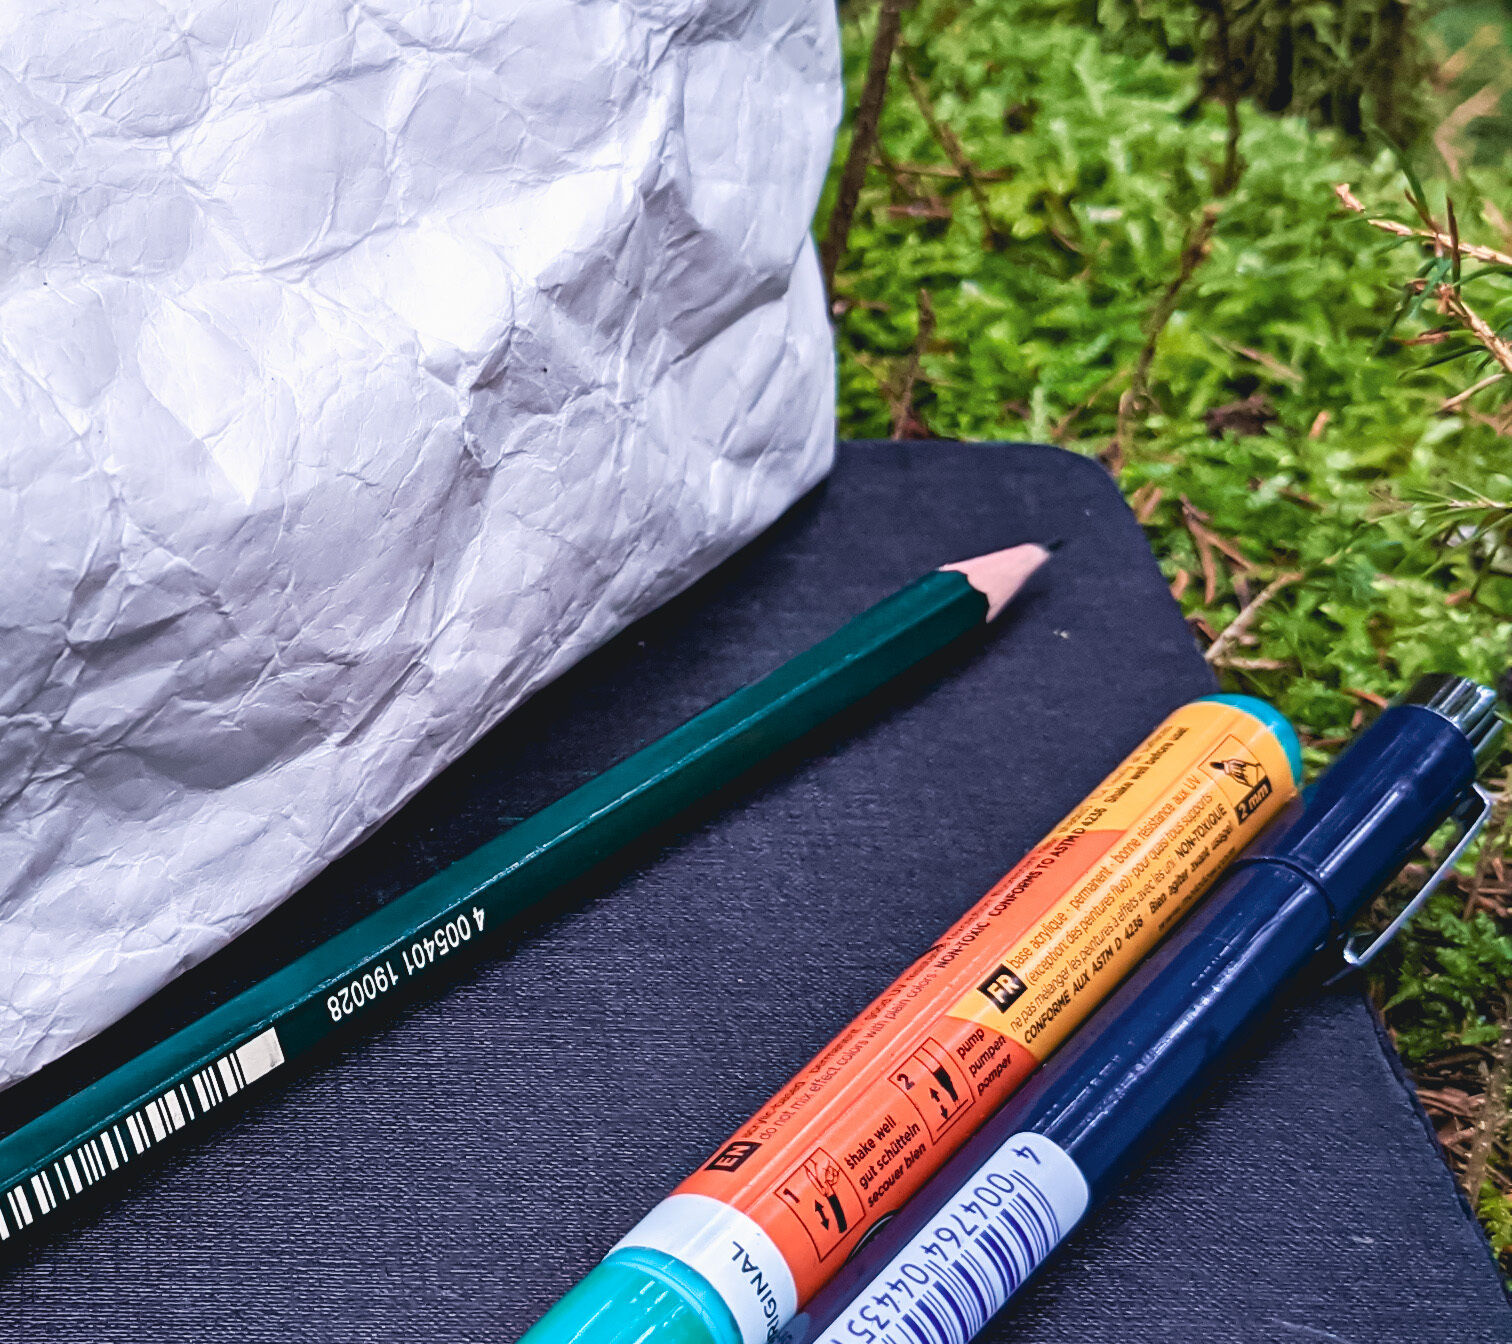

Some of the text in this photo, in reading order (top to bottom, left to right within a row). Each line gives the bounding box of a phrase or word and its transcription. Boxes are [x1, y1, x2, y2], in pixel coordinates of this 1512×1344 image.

[1239, 784, 1269, 821] 2 mm
[1006, 775, 1201, 969] base acrylique permanent bonne résistance aux UV
[1066, 925, 1083, 945] des
[1079, 893, 1116, 934] peintures
[1132, 855, 1151, 879] pour
[1148, 838, 1169, 861] quasi
[1166, 821, 1185, 842] tous
[1181, 793, 1213, 827] supports
[1010, 1016, 1023, 1032] ne
[1020, 1005, 1037, 1025] pas
[1066, 955, 1082, 972] les
[1079, 922, 1115, 964] peintures
[1117, 896, 1139, 923] effets
[1136, 879, 1156, 902] avec
[1151, 869, 1165, 885] les
[1174, 803, 1227, 860] NON-TOXIQUE
[327, 906, 486, 1023] 4 005401 190028
[759, 1127, 777, 1140] do
[774, 1110, 795, 1127] not
[791, 1093, 811, 1110] mix
[809, 1067, 840, 1092] effect
[837, 1040, 868, 1066] colors
[864, 1019, 888, 1038] with
[885, 999, 910, 1020] plain
[907, 974, 936, 998] colors
[935, 921, 990, 969] NON-TOXIC
[988, 870, 1042, 917] CONFORMS
[1035, 857, 1055, 869] TO
[1072, 827, 1086, 835] D
[1131, 766, 1150, 780] well
[1024, 989, 1071, 1044] CONFORME
[1072, 969, 1091, 996] AUX
[1114, 936, 1122, 951] D
[1124, 914, 1143, 940] 4236
[1149, 892, 1167, 914] Bien
[987, 973, 1021, 1004] FR
[956, 1028, 985, 1060] pump
[968, 1034, 1007, 1077] pumpen
[896, 1073, 916, 1091] 2
[976, 1053, 1012, 1097] pomper
[714, 1144, 750, 1169] EN
[845, 1114, 897, 1170] shake well
[859, 1121, 921, 1190] gut schütteln
[1011, 1146, 1041, 1165] 4
[783, 1188, 800, 1203] 1
[867, 1143, 927, 1207] secouer bien
[921, 1173, 1015, 1261] 004764
[731, 1240, 780, 1342] RIGINAL
